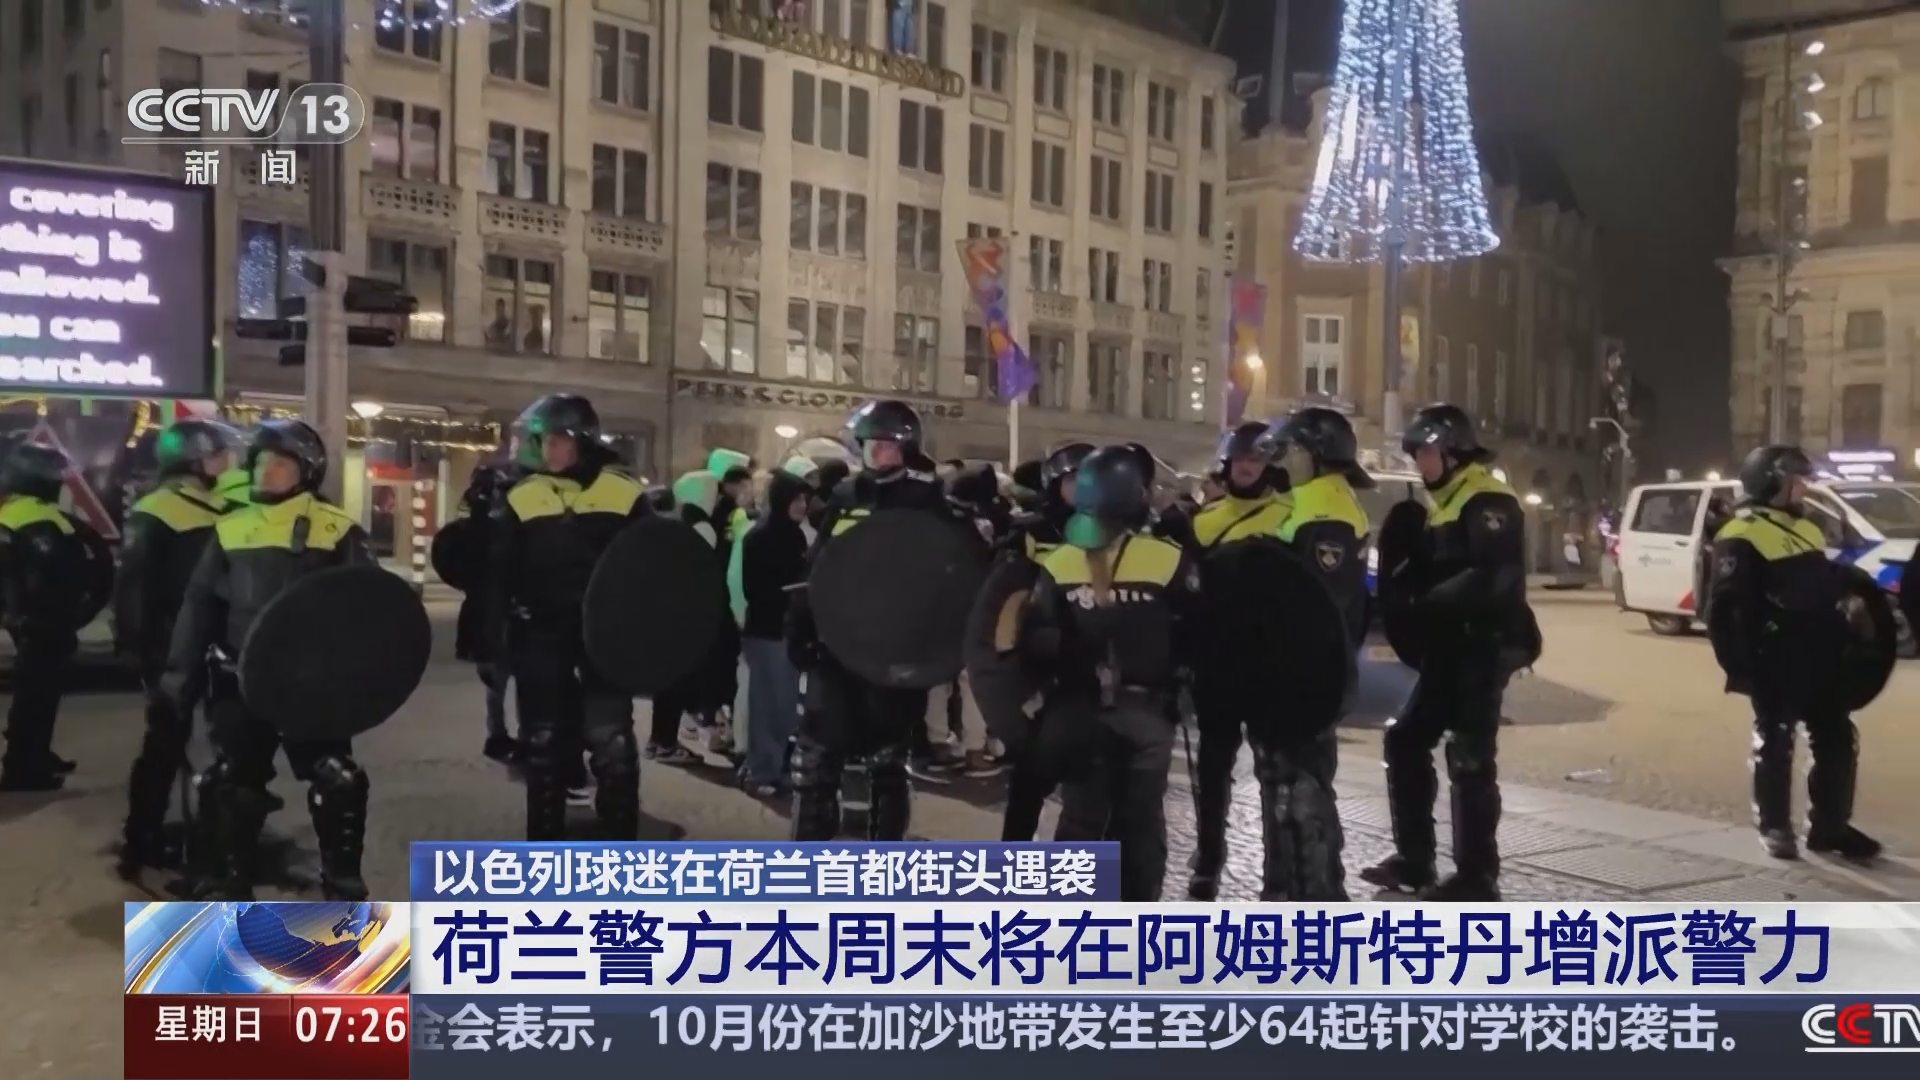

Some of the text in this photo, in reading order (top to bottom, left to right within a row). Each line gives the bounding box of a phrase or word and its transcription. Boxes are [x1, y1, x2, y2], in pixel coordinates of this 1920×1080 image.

[10, 187, 174, 233] covering
[108, 230, 142, 263] is
[50, 316, 120, 343] can
